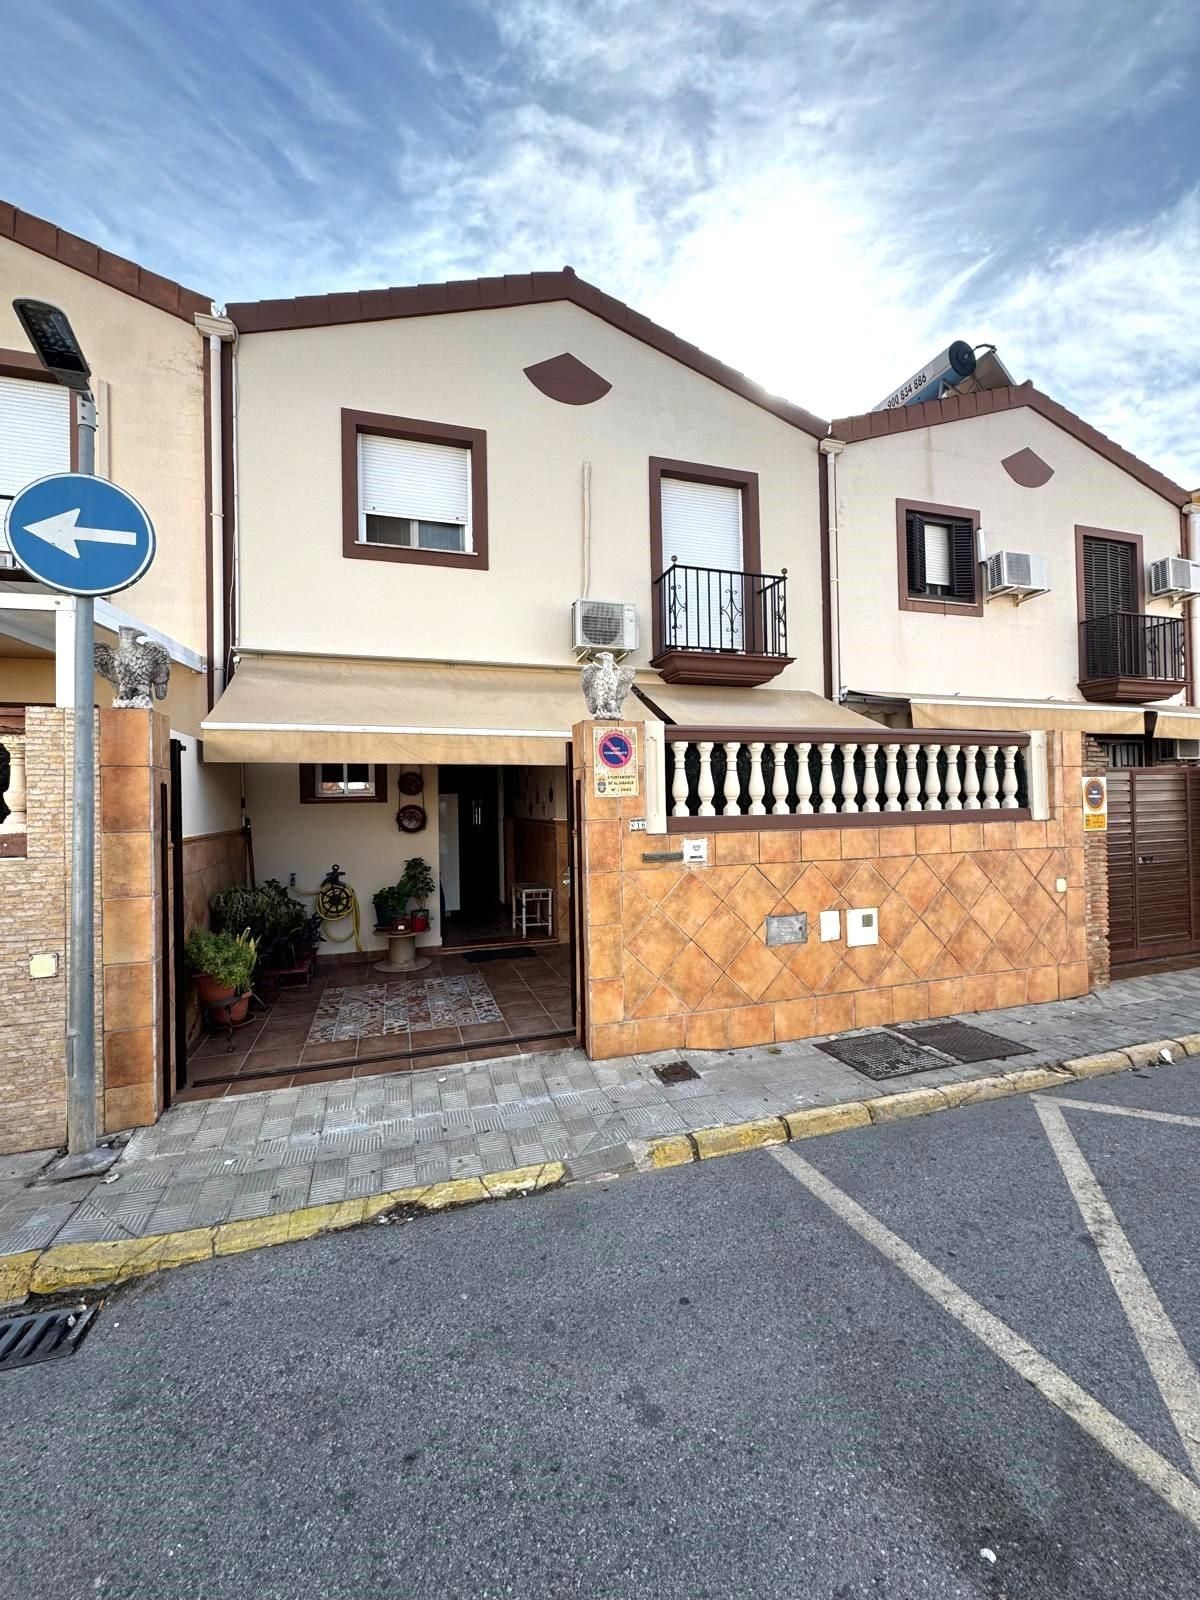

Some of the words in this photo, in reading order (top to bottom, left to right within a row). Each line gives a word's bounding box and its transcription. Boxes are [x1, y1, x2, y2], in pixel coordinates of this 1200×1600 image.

[887, 394, 899, 409] 900
[901, 384, 912, 400] 834
[913, 373, 927, 390] 886
